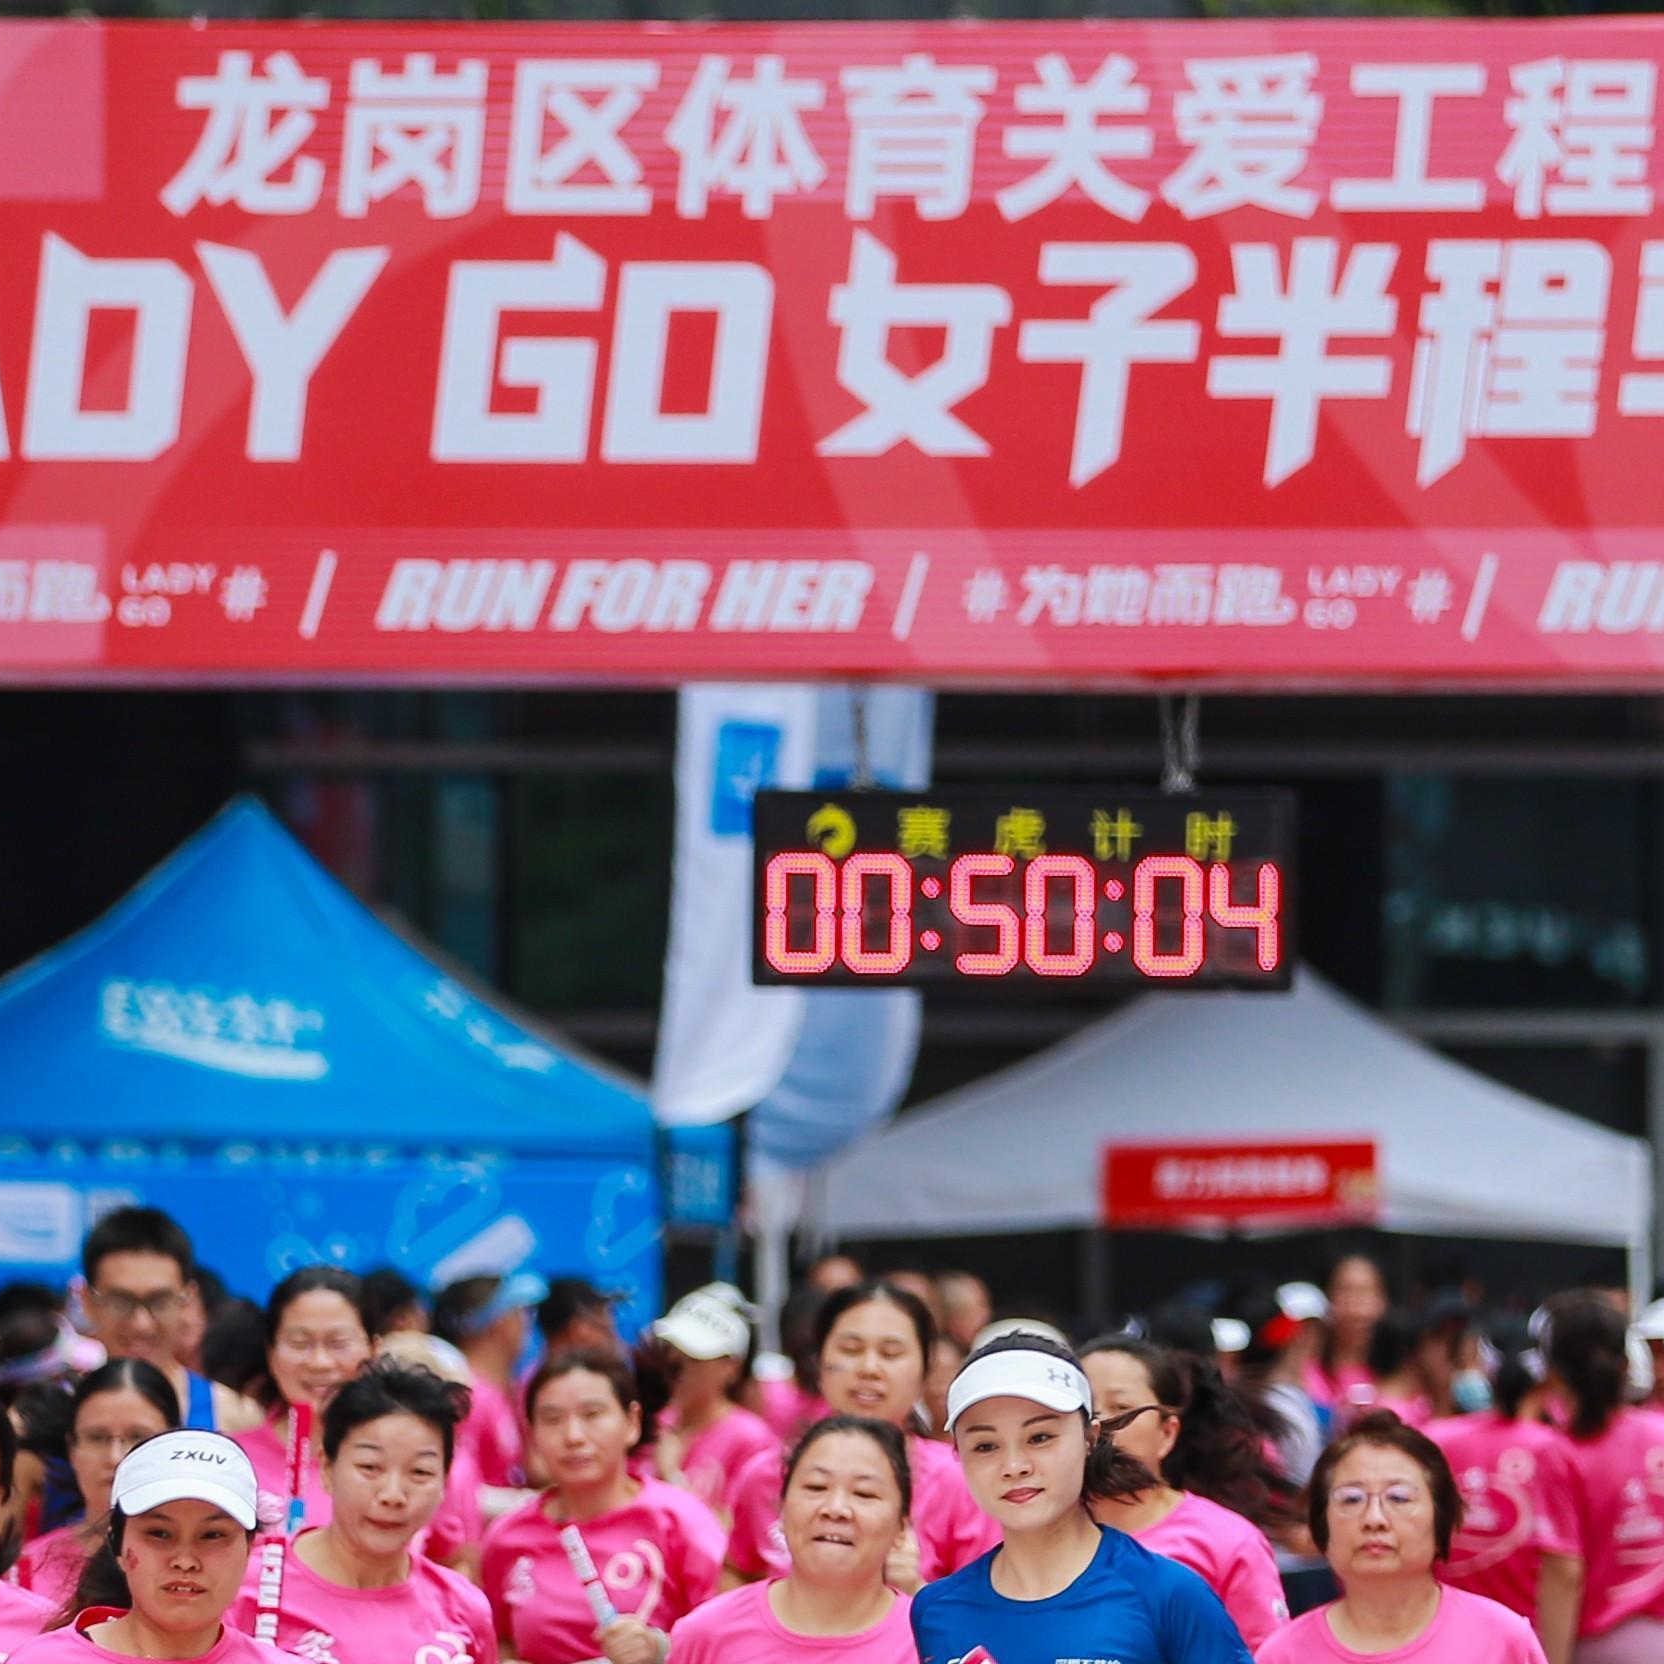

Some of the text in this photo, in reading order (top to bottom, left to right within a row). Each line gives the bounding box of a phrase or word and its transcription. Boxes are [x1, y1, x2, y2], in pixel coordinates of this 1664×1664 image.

[162, 52, 1658, 220] 龙岗区体育关爱工程
[430, 232, 776, 463] GO
[375, 558, 875, 633] RUN FOR HER
[897, 804, 1238, 862] 赛虎计时
[765, 852, 1280, 977] 00:50:04
[170, 1450, 228, 1465] ZXUV
